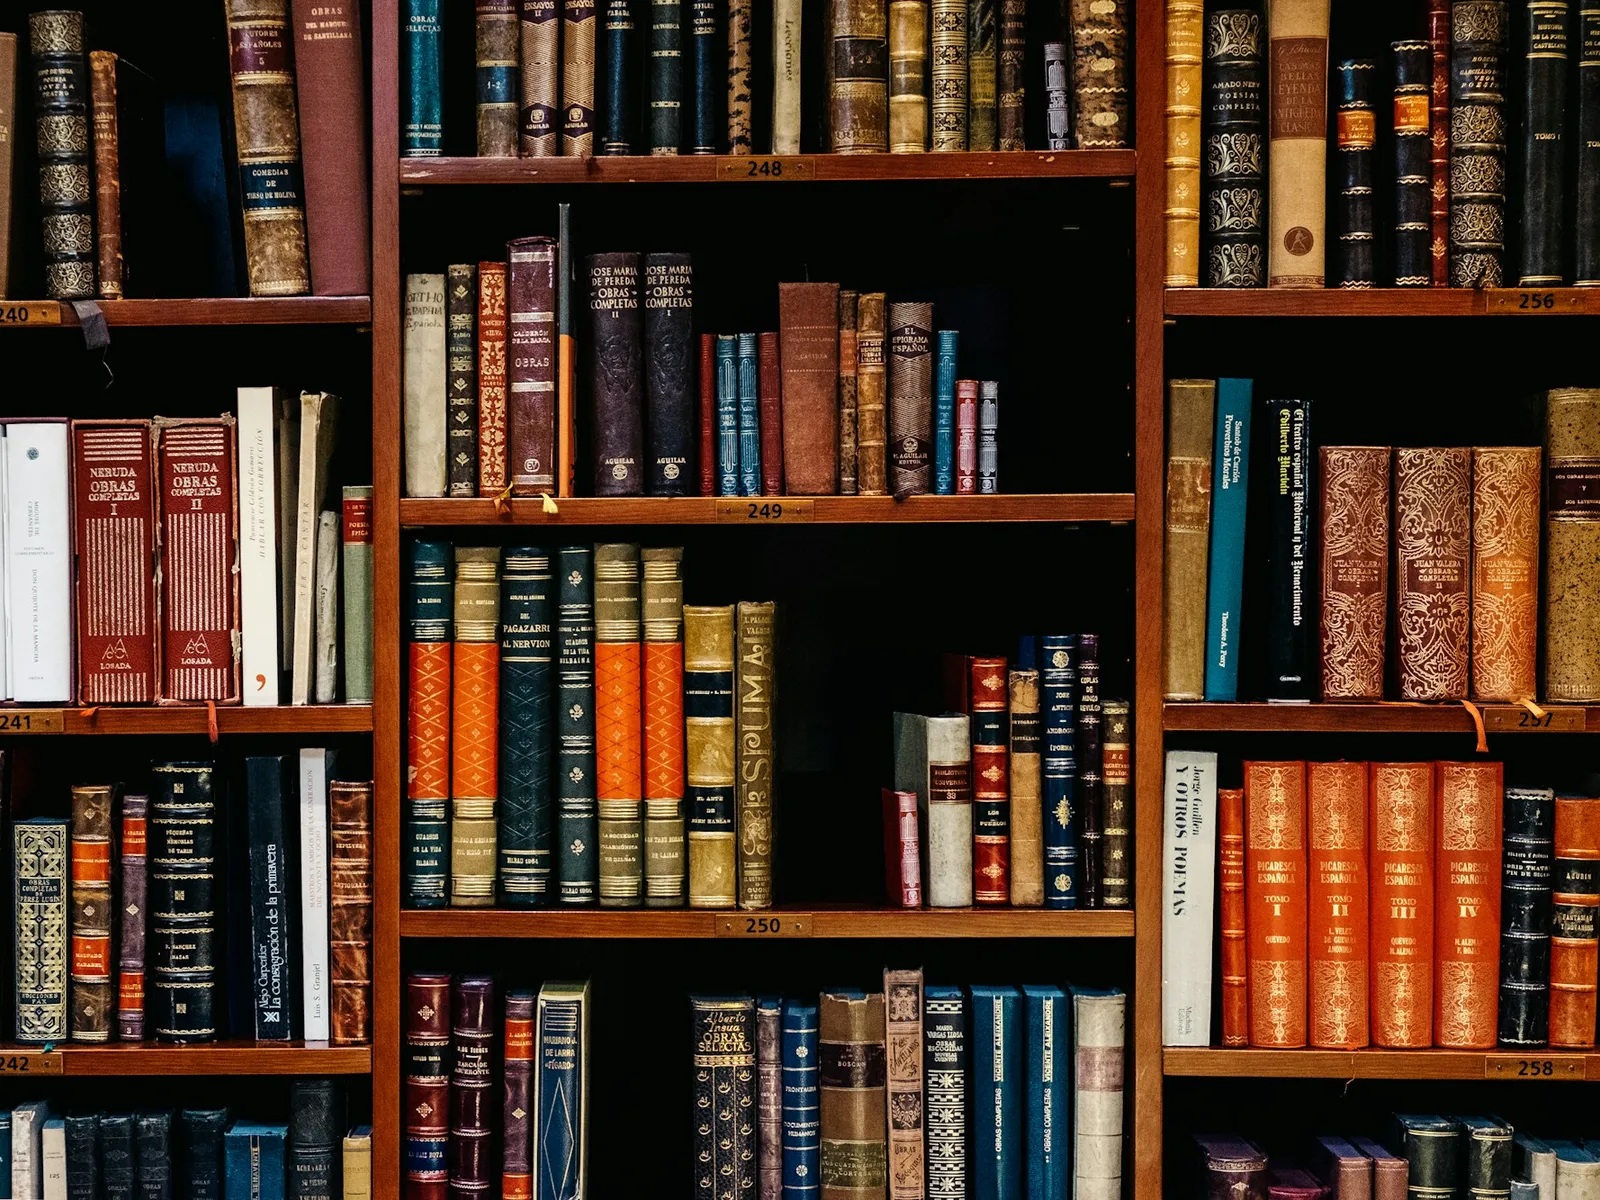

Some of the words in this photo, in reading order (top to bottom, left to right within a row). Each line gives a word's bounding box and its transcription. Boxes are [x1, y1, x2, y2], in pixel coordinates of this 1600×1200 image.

[524, 2, 555, 10] ENSAYOS
[564, 1, 595, 9] ENSAYOS
[312, 8, 343, 16] OBRAS
[410, 15, 436, 23] OBRAS
[405, 25, 441, 33] SELECTAS
[786, 19, 794, 81] Lecciones
[1212, 81, 1240, 89] AMADO
[748, 161, 782, 176] 248
[589, 268, 611, 277] JOSE
[613, 267, 638, 276] MARIA
[645, 266, 667, 275] JOSE
[669, 266, 693, 275] MARIA
[592, 278, 602, 286] DE
[605, 277, 636, 286] PEREDA
[647, 276, 657, 285] DE
[660, 276, 691, 284] PEREDA
[408, 292, 443, 303] ORTHO
[598, 288, 630, 298] OBRAS
[653, 287, 684, 297] OBRAS
[590, 299, 638, 310] COMPLETAS
[645, 298, 692, 308] COMPLETAS
[1519, 294, 1555, 309] 256
[406, 318, 443, 331] Española
[892, 336, 928, 344] EPIGRAMA
[893, 344, 928, 352] ESPAÑOL
[515, 358, 550, 367] OBRAS
[1293, 409, 1304, 421] El
[1224, 414, 1234, 457] Proverbios
[1280, 409, 1291, 454] Edilberto
[1294, 422, 1303, 451] teatro
[1234, 446, 1241, 455] de
[255, 429, 264, 493] CORRECCIÓN
[90, 468, 137, 478] NERUDA
[172, 463, 219, 473] NERUDA
[1232, 457, 1241, 484] Carrión
[1292, 452, 1304, 488] español
[1222, 458, 1232, 490] Morales
[91, 481, 135, 492] OBRAS
[173, 476, 218, 488] OBRAS
[89, 492, 140, 502] COMPLETAS
[171, 487, 222, 496] COMPLETAS
[111, 504, 118, 516] I
[191, 499, 203, 510] II
[748, 504, 782, 519] 249
[1291, 491, 1304, 535] Medieval
[302, 502, 310, 550] CANTAR
[1292, 535, 1300, 543] y
[1293, 545, 1304, 558] del
[1334, 560, 1354, 568] JUAN
[1355, 560, 1381, 568] VALERA
[1414, 560, 1434, 568] JUAN
[1436, 560, 1461, 568] VALERA
[1291, 560, 1304, 626] Renacimiento
[503, 624, 550, 633] PAGAZARRI
[1221, 612, 1229, 641] Theodore
[502, 640, 511, 648] AL
[513, 640, 550, 648] NERVION
[1221, 641, 1227, 650] A.
[1218, 650, 1227, 668] Perry
[100, 662, 131, 670] LOSADA
[0, 716, 31, 730] 241
[1518, 712, 1554, 727] 257
[1176, 766, 1189, 776] Y
[1191, 766, 1205, 795] Jorge
[946, 792, 956, 800] 33
[1175, 782, 1189, 838] OTROS
[1192, 798, 1203, 836] Guillén
[265, 844, 281, 894] primavera
[1257, 861, 1296, 872] PICARESCA
[1320, 861, 1358, 872] PICARESCA
[1384, 863, 1423, 873] PICARESCA
[1451, 862, 1489, 872] PICARESCA
[1173, 847, 1188, 917] POEMAS
[1258, 872, 1295, 884] ESPAÑOLA
[1321, 872, 1358, 884] ESPAÑOLA
[1385, 875, 1422, 886] ESPAÑOLA
[1451, 874, 1488, 884] ESPAÑOLA
[265, 896, 278, 905] la
[1457, 897, 1482, 905] TOMO
[1273, 904, 1281, 916] I
[1332, 904, 1348, 916] II
[1391, 906, 1416, 919] III
[1460, 905, 1480, 918] IV
[266, 908, 278, 925] de
[746, 918, 781, 933] 250
[1265, 936, 1291, 944] QUEVEDO
[1391, 937, 1417, 945] QUEVEDO
[268, 926, 284, 995] consagración
[258, 944, 270, 989] Carpentier
[313, 964, 322, 991] Granjel
[259, 989, 271, 1009] Alejo
[268, 996, 282, 1009] La
[704, 1012, 746, 1024] Alberto
[708, 1022, 740, 1033] Insua
[544, 1035, 570, 1045] MARIANO
[571, 1036, 577, 1045] J.
[704, 1032, 745, 1043] OBRAS
[698, 1042, 751, 1052] SELECTAS
[546, 1049, 556, 1057] DE
[558, 1049, 575, 1057] LARRA
[0, 1057, 29, 1071] 242
[545, 1059, 575, 1070] «FÍGARO»
[995, 1050, 1003, 1081] VICENTE
[1044, 1050, 1052, 1081] VICENTE
[1518, 1061, 1554, 1076] 258
[1044, 1088, 1052, 1127] COMPLETAS
[1044, 1129, 1052, 1152] OBRAS
